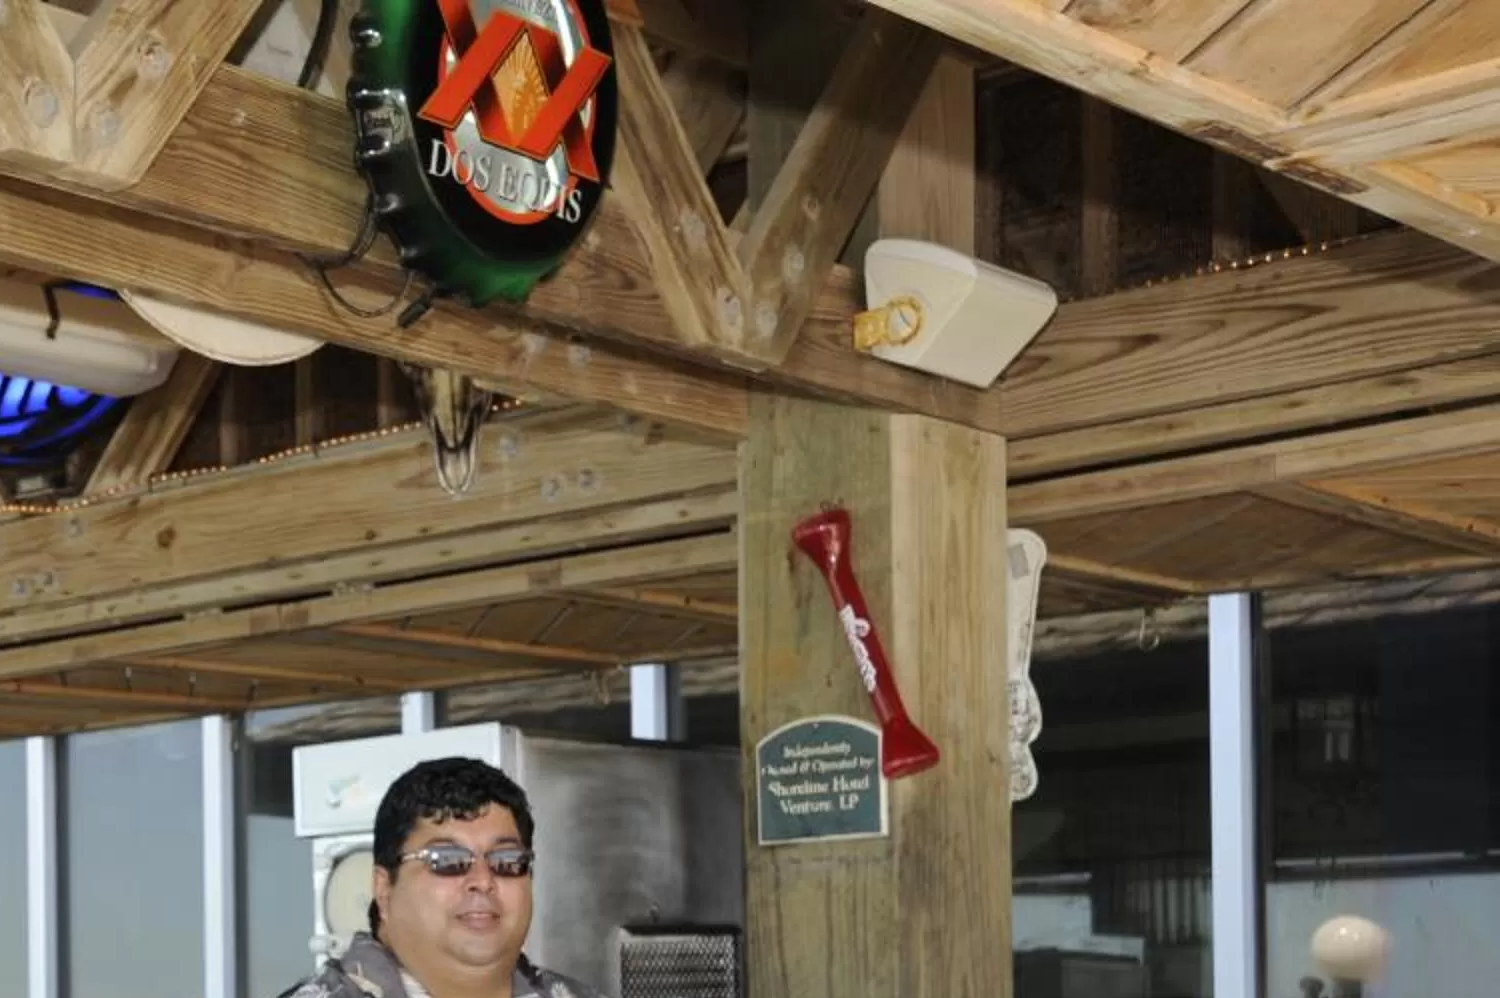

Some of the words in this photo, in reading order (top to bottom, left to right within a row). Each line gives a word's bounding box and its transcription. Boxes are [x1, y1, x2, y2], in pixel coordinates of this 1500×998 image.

[429, 138, 491, 192] DOS
[500, 162, 582, 224] EQUIS
[768, 781, 830, 797] Shoreline
[832, 774, 870, 793] Hotel
[839, 793, 860, 811] LP
